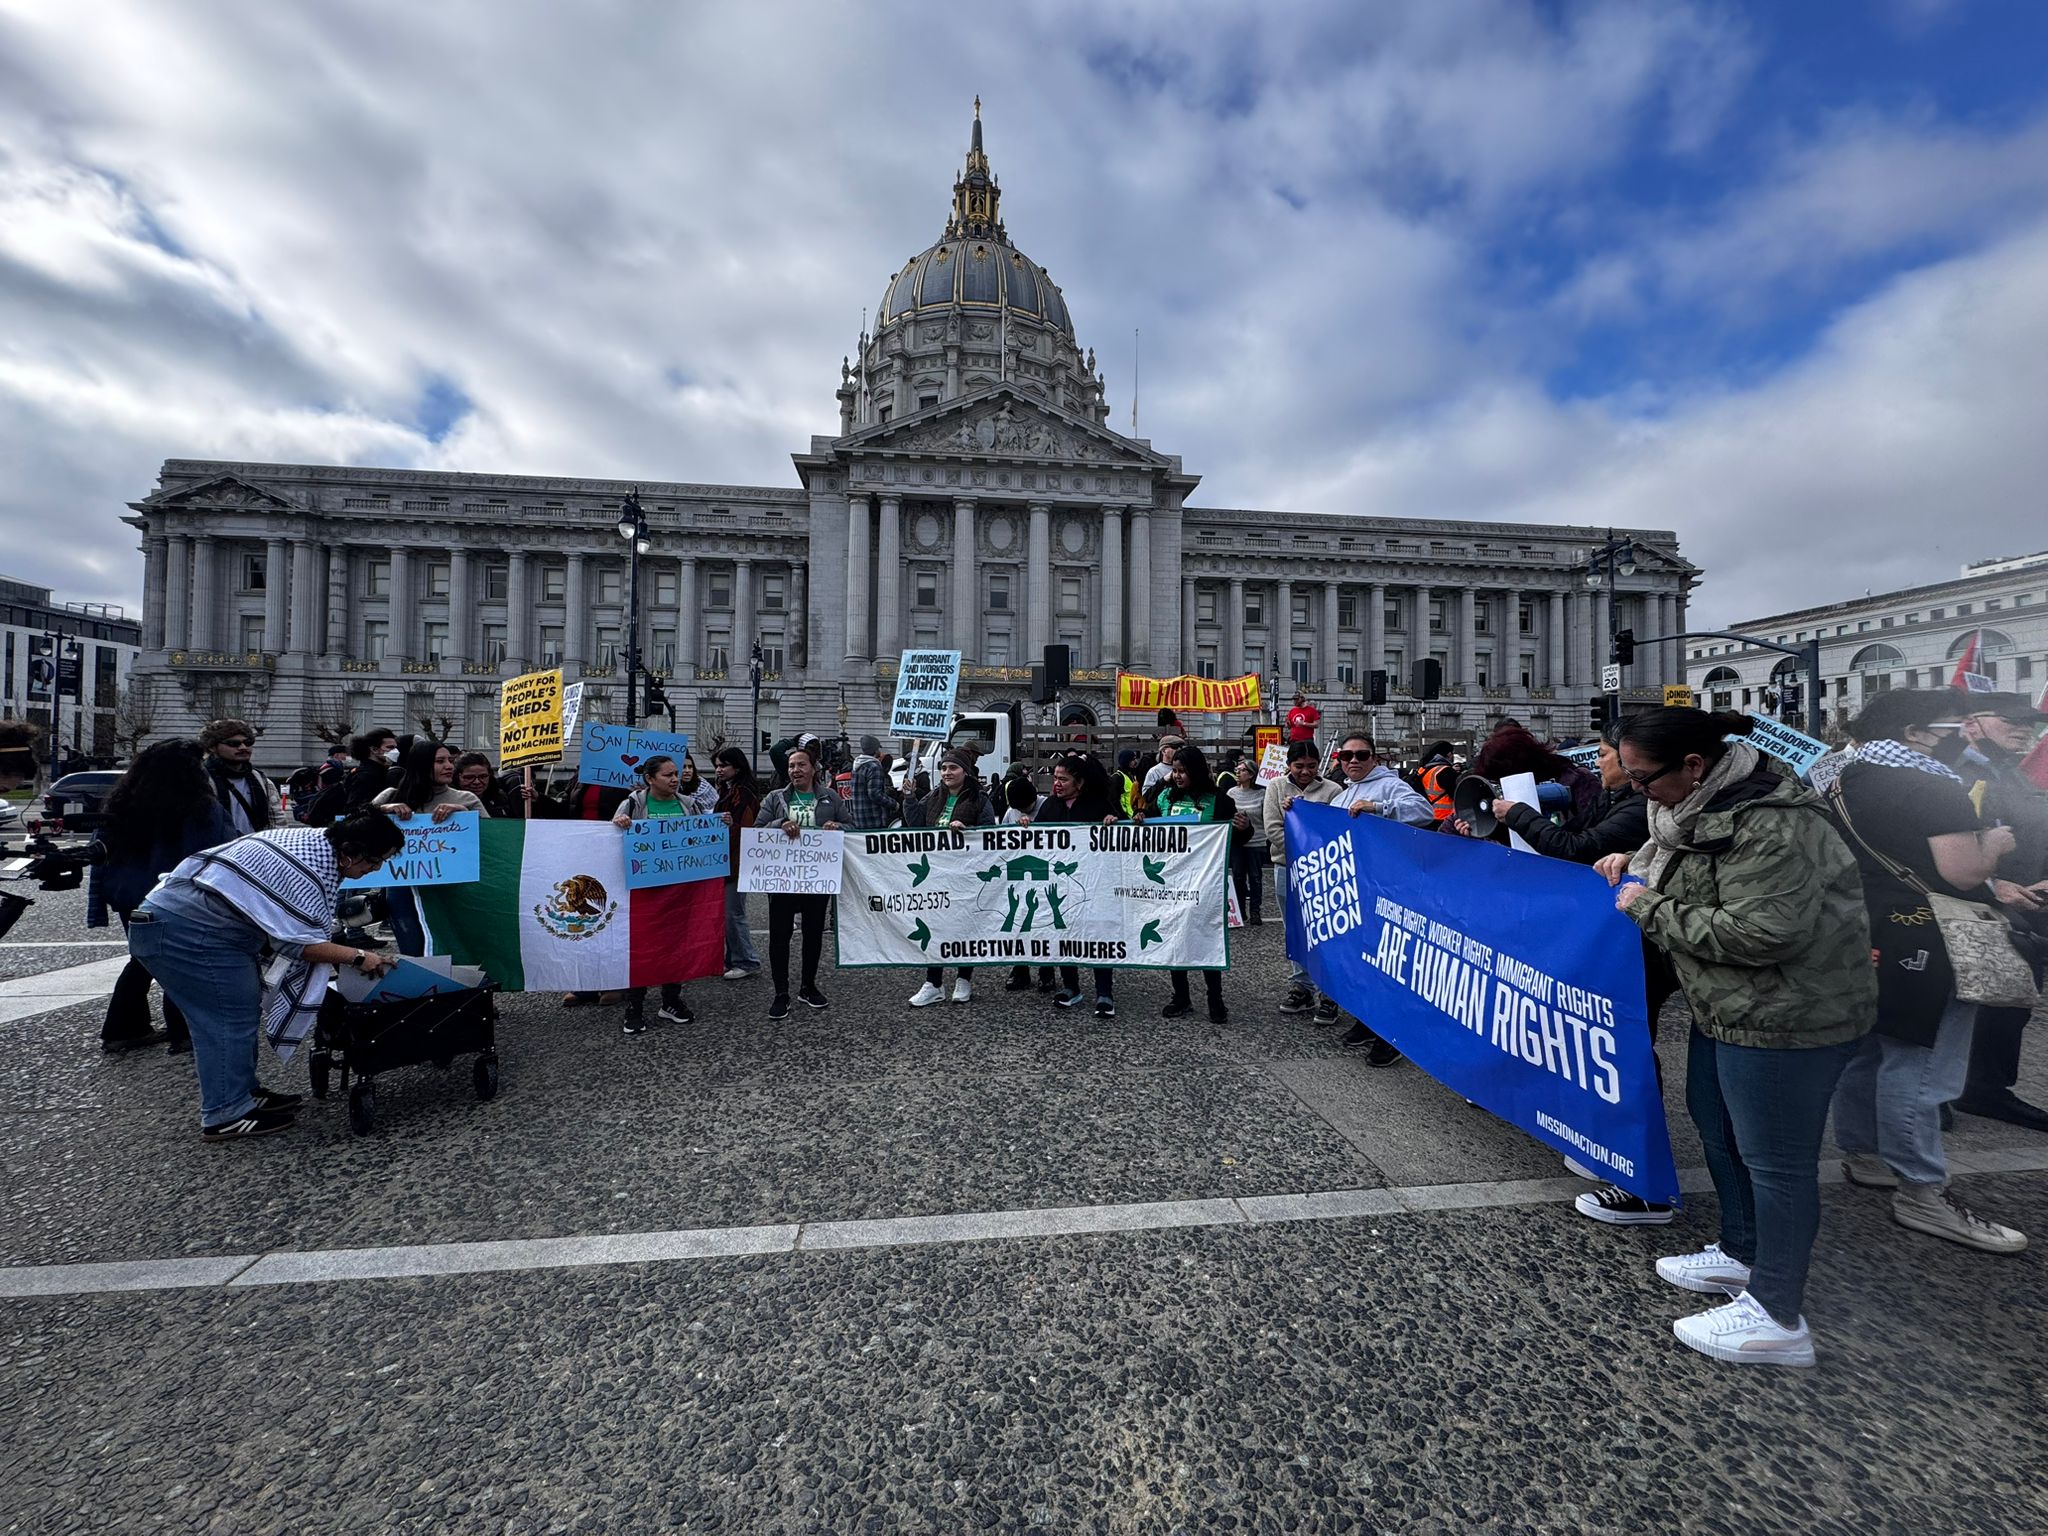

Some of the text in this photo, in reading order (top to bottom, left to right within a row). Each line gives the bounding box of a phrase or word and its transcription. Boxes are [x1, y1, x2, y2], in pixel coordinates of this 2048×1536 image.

[912, 654, 951, 664] IMMIGRANT
[904, 664, 954, 674] AND WORKERS
[506, 676, 556, 694] MONEY FOR
[906, 676, 948, 691] RIGHTS
[1604, 678, 1618, 688] 20
[505, 686, 556, 706] PEOPLE'S
[1129, 680, 1150, 706] WE
[1156, 680, 1198, 706] FIGHT
[1202, 681, 1250, 708] BACK!
[509, 700, 550, 720] NEEDS
[897, 699, 949, 710] ONE STRUGGLE
[895, 712, 946, 728] ONE FIGHT
[503, 722, 559, 744] NOT THE
[1752, 717, 1821, 756] RABAJADORES
[503, 736, 560, 754] WAR MACHINE
[1786, 752, 1805, 764] AL
[626, 822, 650, 836] LOS
[408, 839, 456, 854] BACK,
[633, 832, 724, 853] SON EL CORAZON
[866, 826, 1192, 854] DIGNIDAD, RESPETO, SOLIDARIDAD.
[632, 853, 728, 875] DE SAN FRANCISCO
[748, 848, 838, 862] COMO PERSONAS
[388, 857, 442, 880] WIN!
[751, 864, 819, 880] MIGRANTES
[1298, 853, 1356, 903] ACTION
[749, 878, 836, 893] NUESTRO DERECHO
[1114, 884, 1200, 905] www.lacolectivademujeres.org
[884, 892, 950, 914] (415) 252-5375
[940, 939, 1126, 958] COLECTIVA DE MUJERES
[1375, 896, 1615, 1028] HOUSING RIGHTS, WORKER RIGHTS, IMMIGRANT RIGHTS
[1410, 938, 1488, 1036] HUMAN
[1491, 981, 1620, 1104] RIGHTS
[1536, 1110, 1634, 1178] MISSIONACTION.ORG
